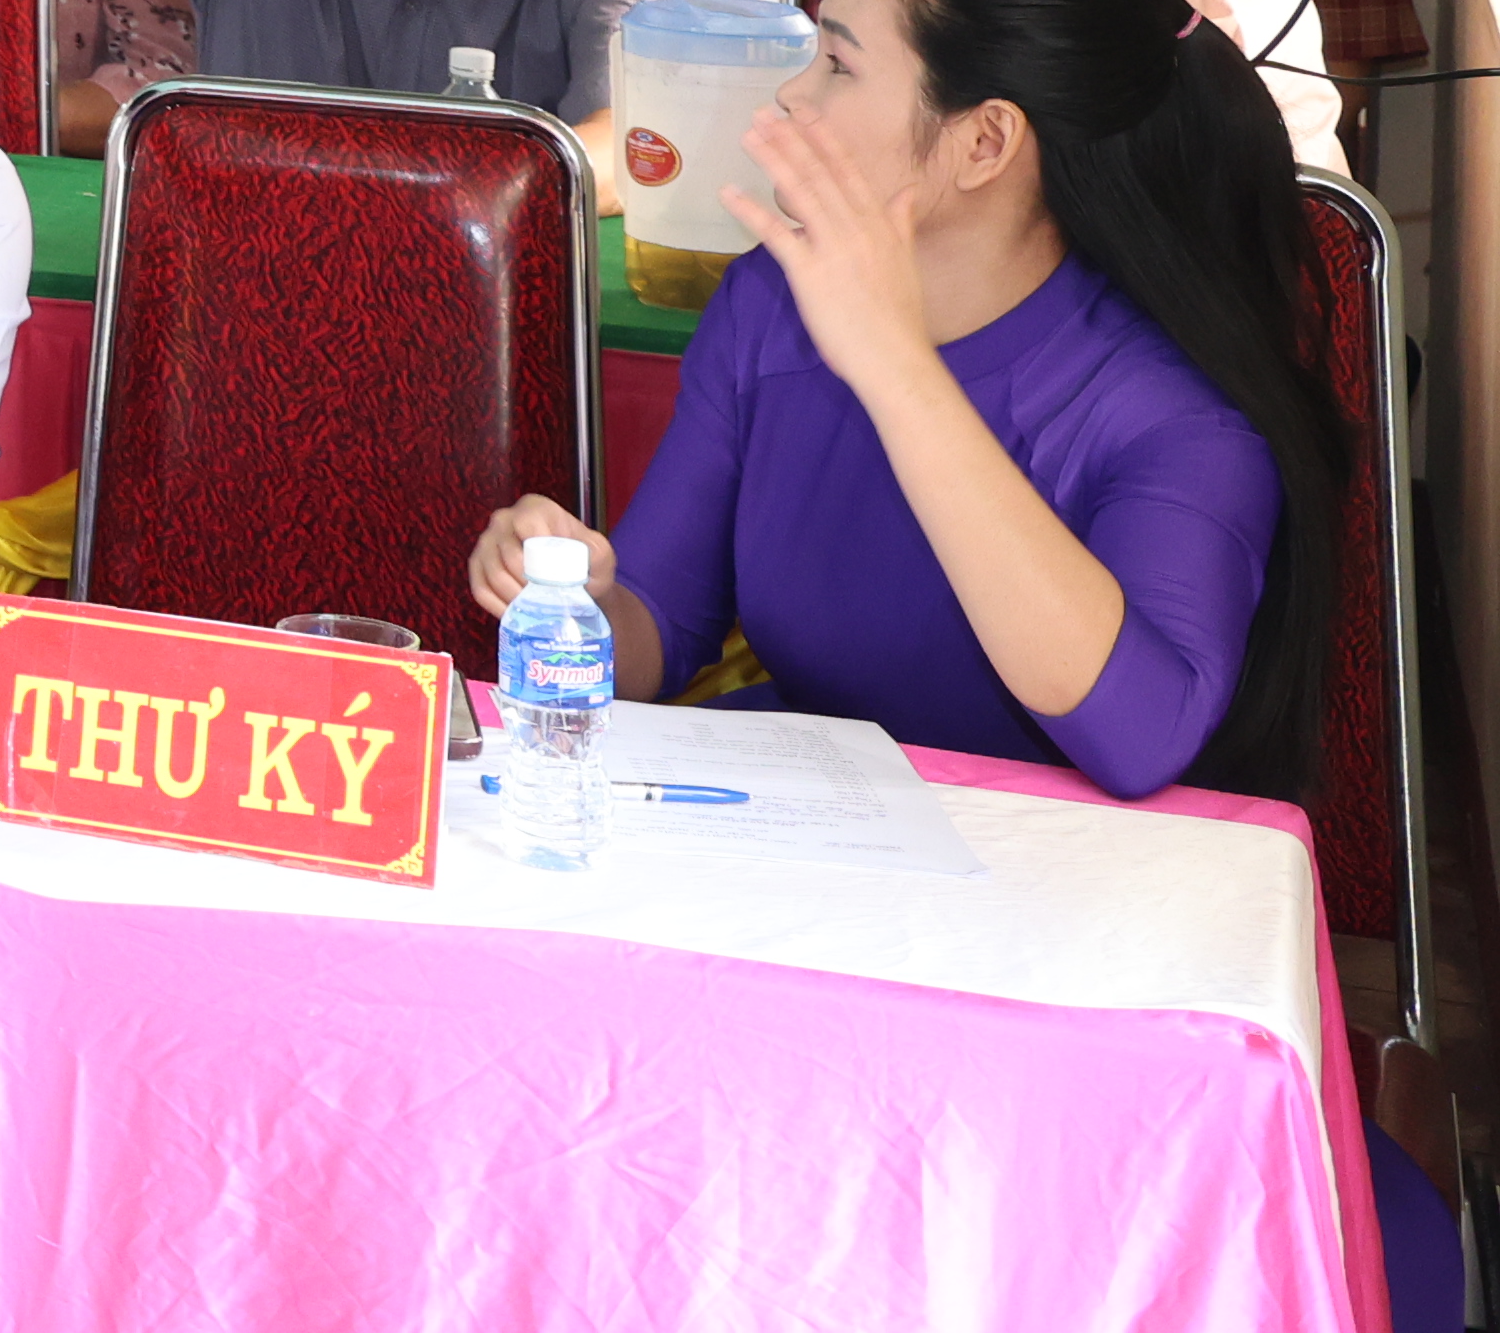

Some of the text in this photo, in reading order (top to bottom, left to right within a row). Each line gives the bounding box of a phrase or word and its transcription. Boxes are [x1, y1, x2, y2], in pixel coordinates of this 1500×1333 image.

[527, 659, 605, 686] Synmat
[13, 676, 395, 825] THƯ KÝ
